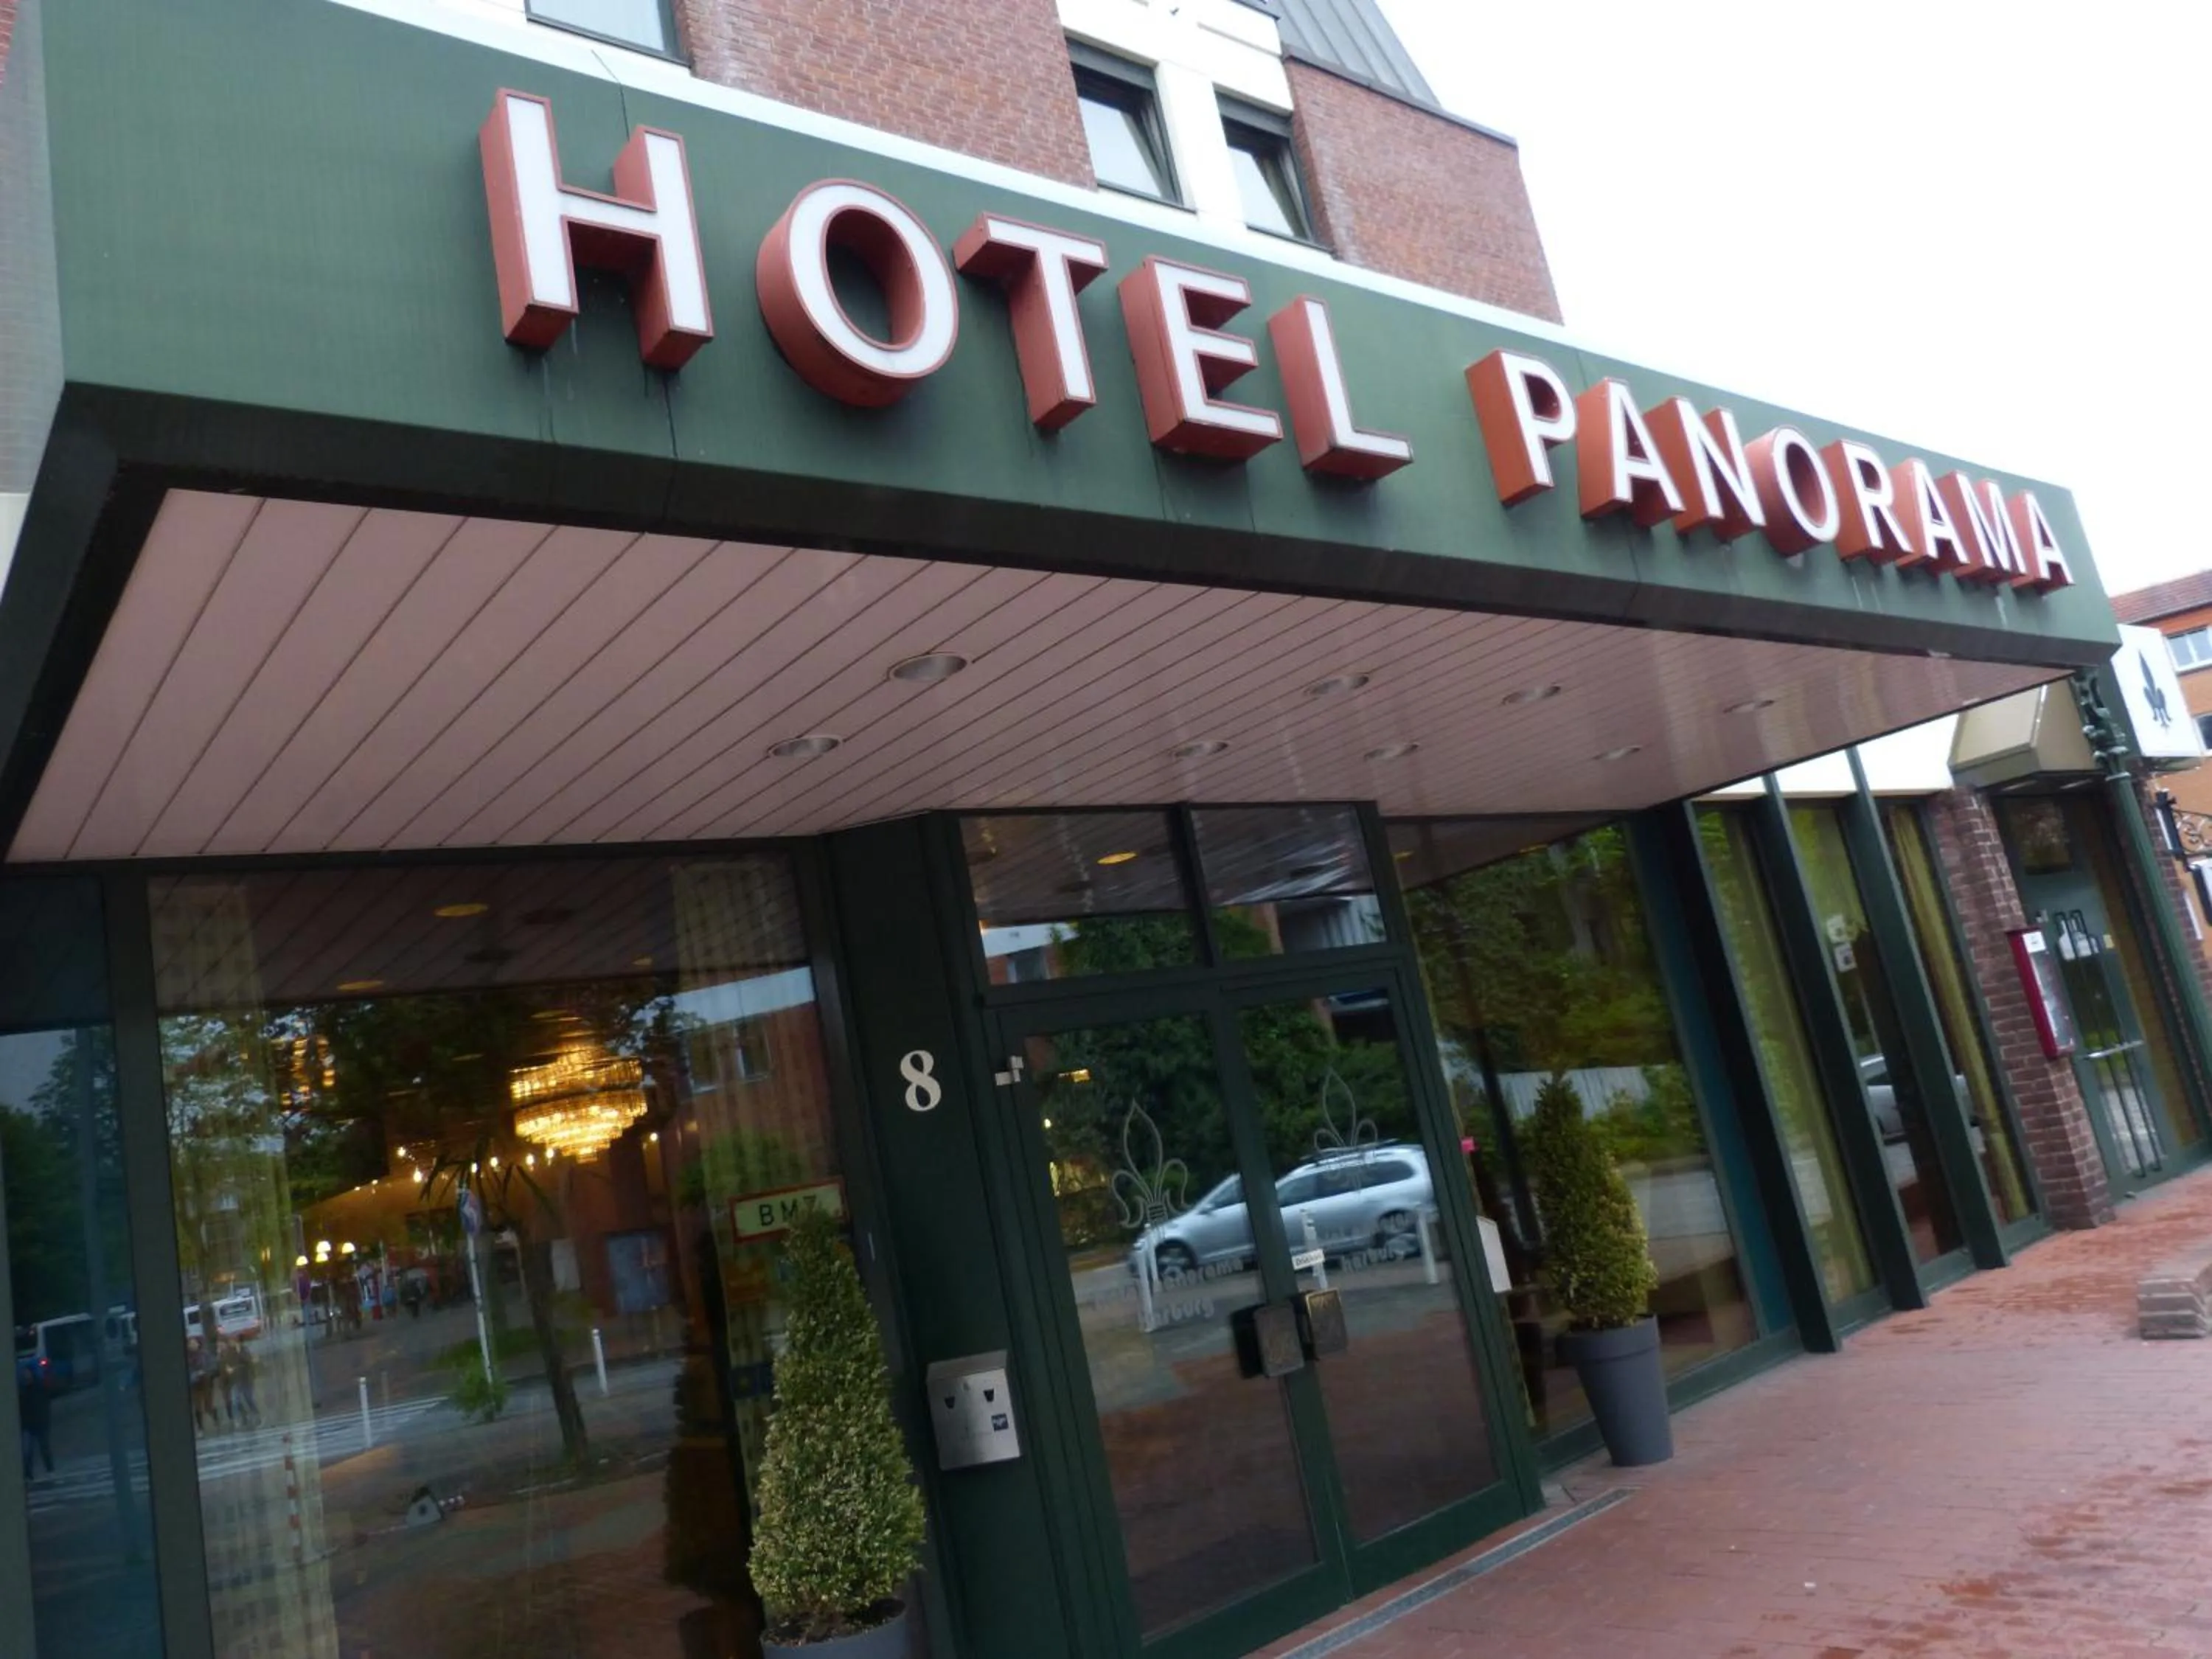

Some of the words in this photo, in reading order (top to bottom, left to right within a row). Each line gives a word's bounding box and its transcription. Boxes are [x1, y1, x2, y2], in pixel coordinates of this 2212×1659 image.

[479, 87, 1414, 481] HOTEL
[1465, 348, 2076, 590] PANORAMA
[900, 1049, 942, 1111] 8
